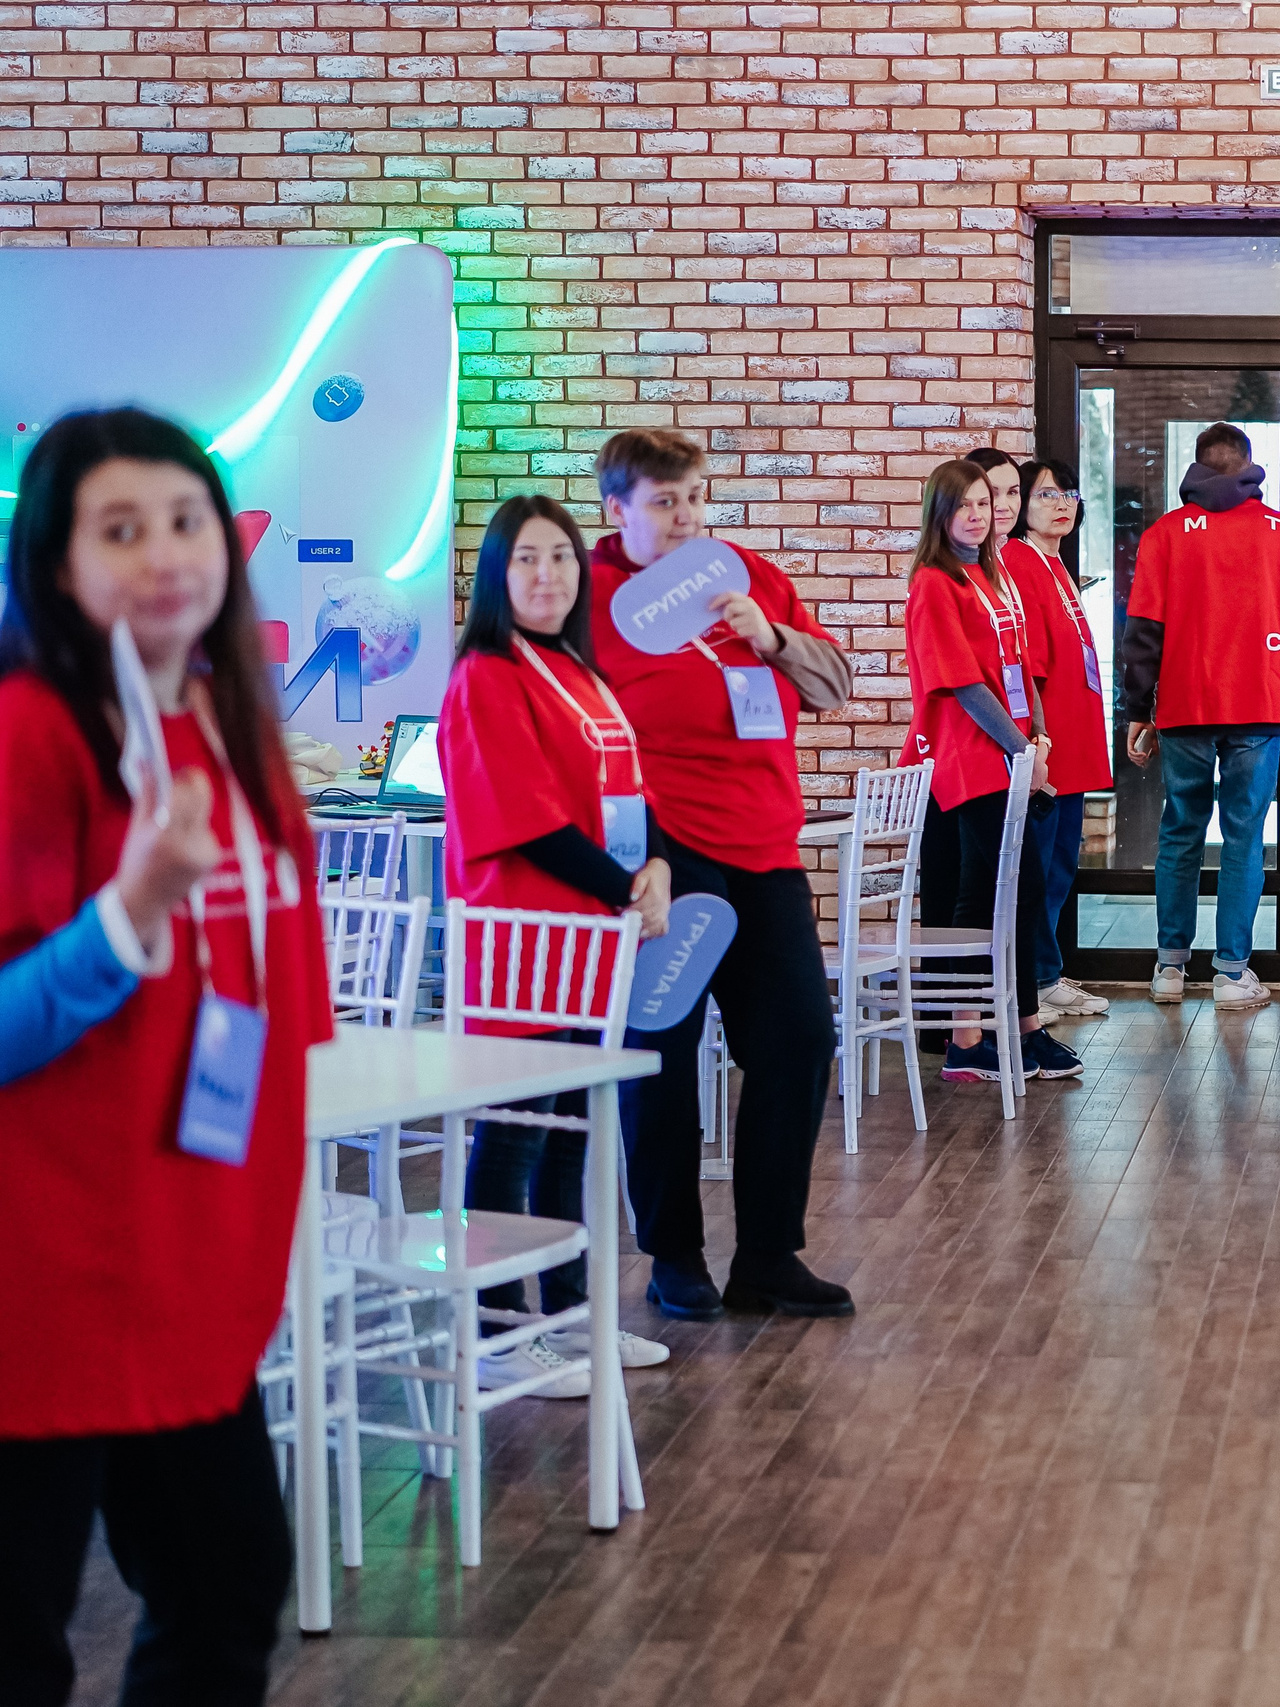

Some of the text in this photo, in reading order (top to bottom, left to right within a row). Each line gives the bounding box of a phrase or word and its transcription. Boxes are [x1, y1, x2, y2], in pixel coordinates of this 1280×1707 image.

[1184, 515, 1207, 533] М
[310, 547, 341, 555] USER 2
[632, 558, 728, 630] ГРУППА 11
[915, 734, 931, 755] С
[642, 911, 712, 1015] ГРУППА 11
